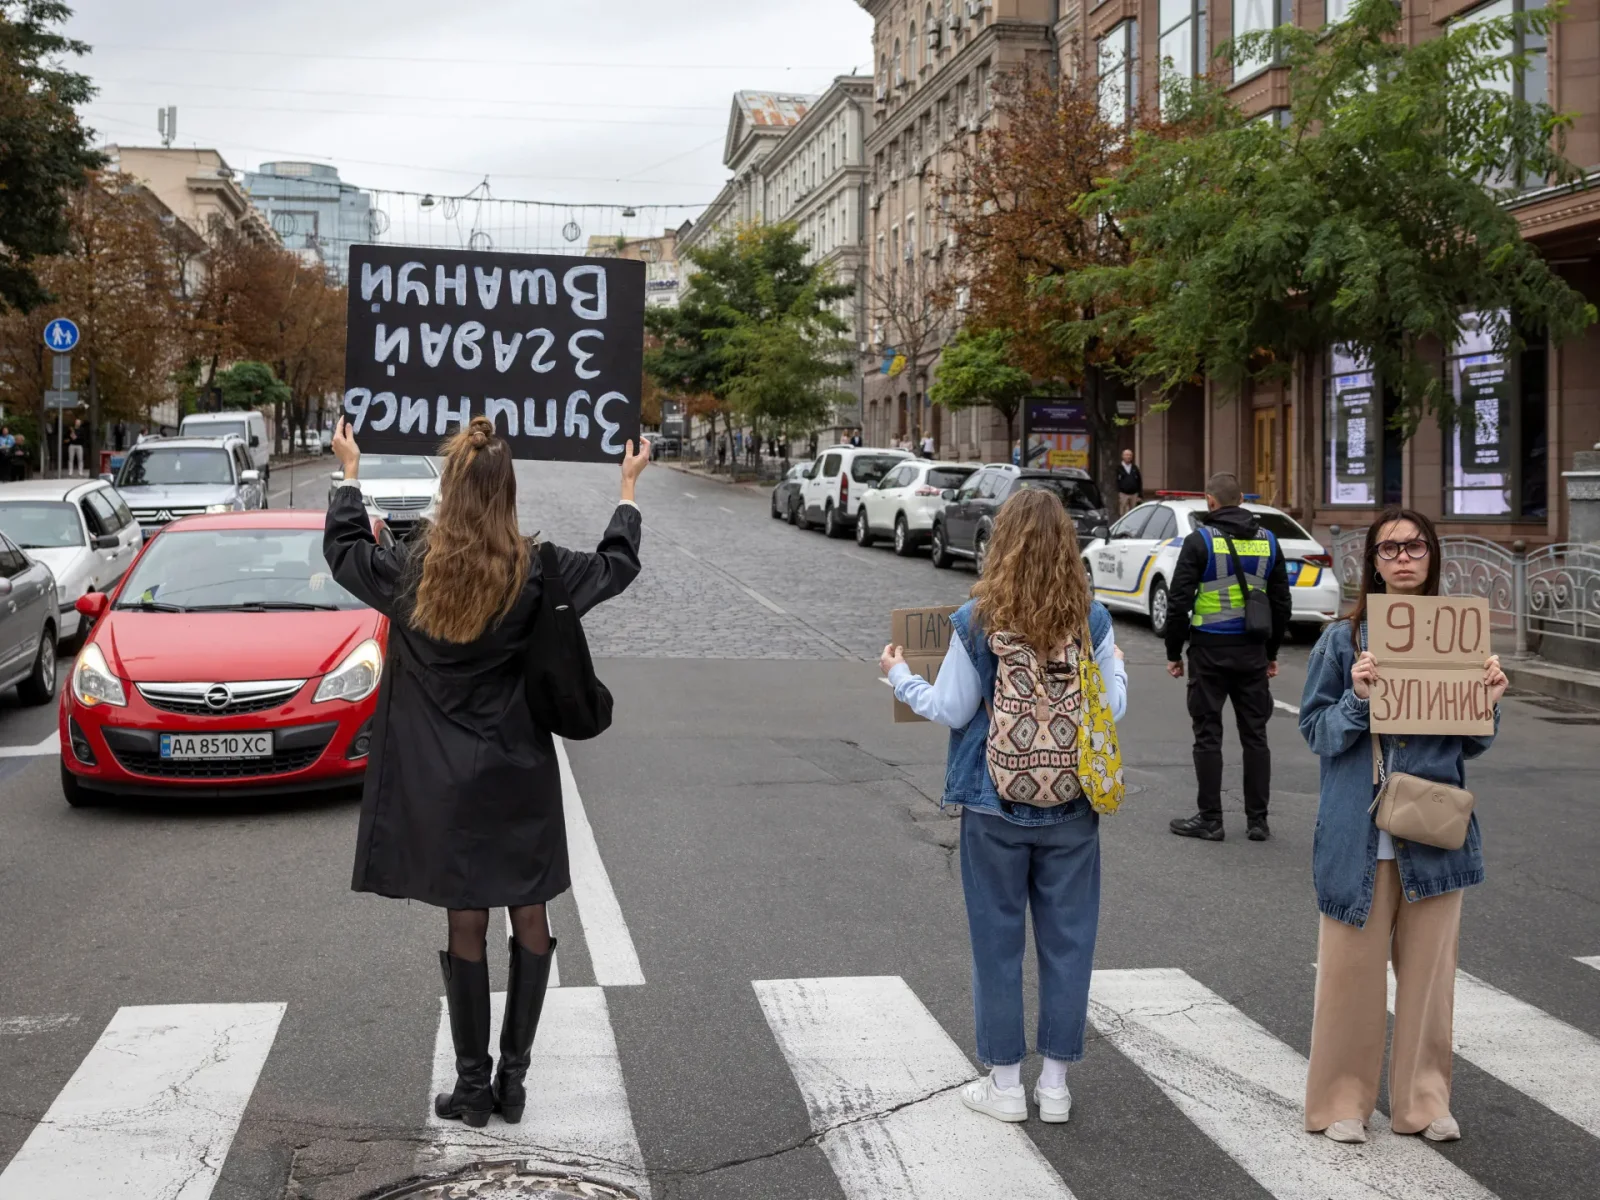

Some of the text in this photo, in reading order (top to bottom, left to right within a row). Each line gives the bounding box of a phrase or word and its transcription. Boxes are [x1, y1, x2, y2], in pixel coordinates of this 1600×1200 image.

[172, 739, 196, 755] AA
[200, 738, 238, 754] 8510
[242, 737, 266, 753] XC
